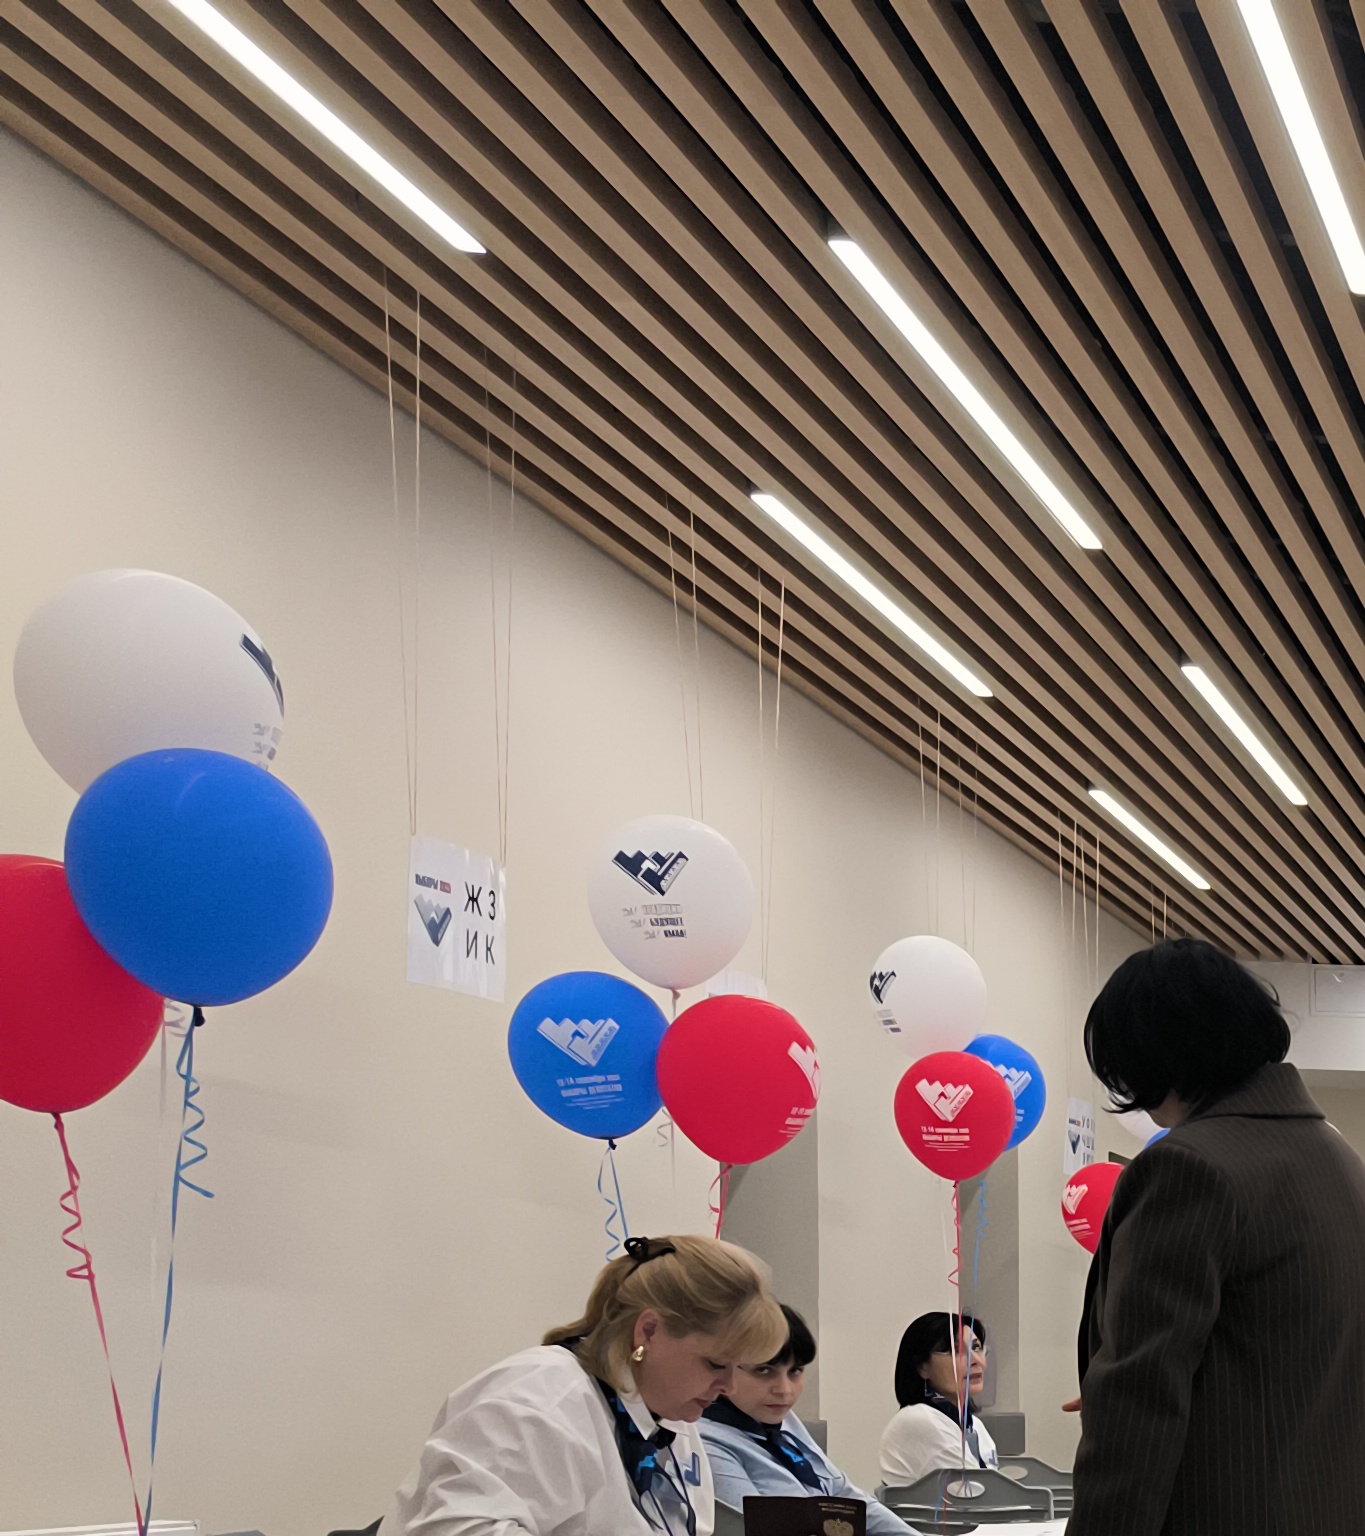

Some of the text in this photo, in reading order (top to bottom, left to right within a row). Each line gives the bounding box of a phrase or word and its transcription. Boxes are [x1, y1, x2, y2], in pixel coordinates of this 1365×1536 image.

[464, 881, 482, 917] Ж
[488, 890, 496, 921] З
[466, 928, 496, 966] И К
